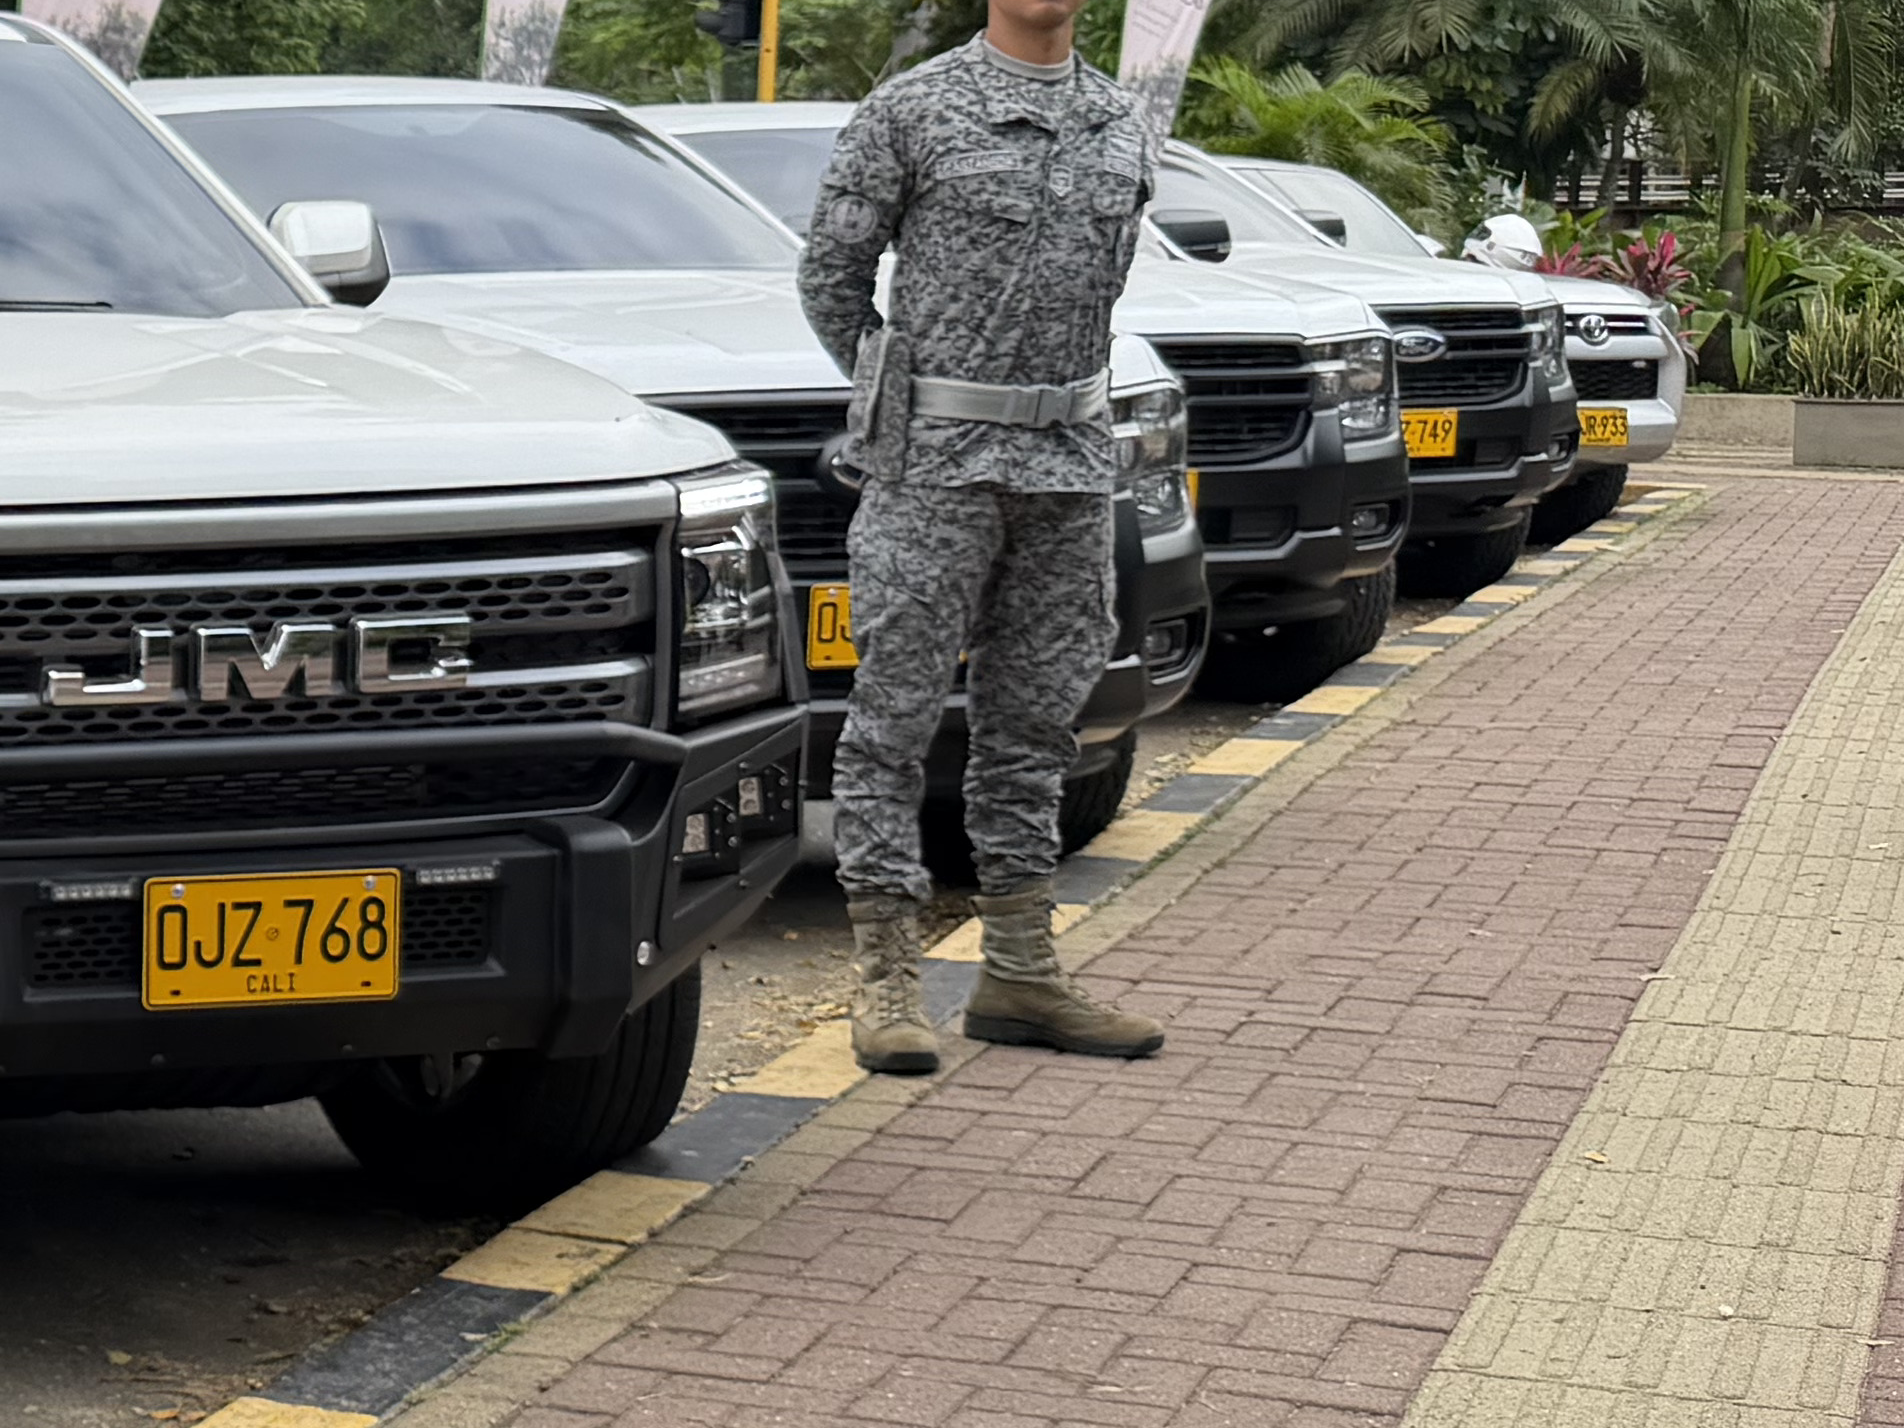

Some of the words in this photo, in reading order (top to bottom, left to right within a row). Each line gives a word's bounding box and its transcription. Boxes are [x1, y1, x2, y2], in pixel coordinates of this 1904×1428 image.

[1417, 420, 1452, 444] 749
[1601, 415, 1627, 436] 933
[44, 613, 472, 706] JMC
[283, 896, 387, 965] 768
[246, 973, 296, 994] CALI
